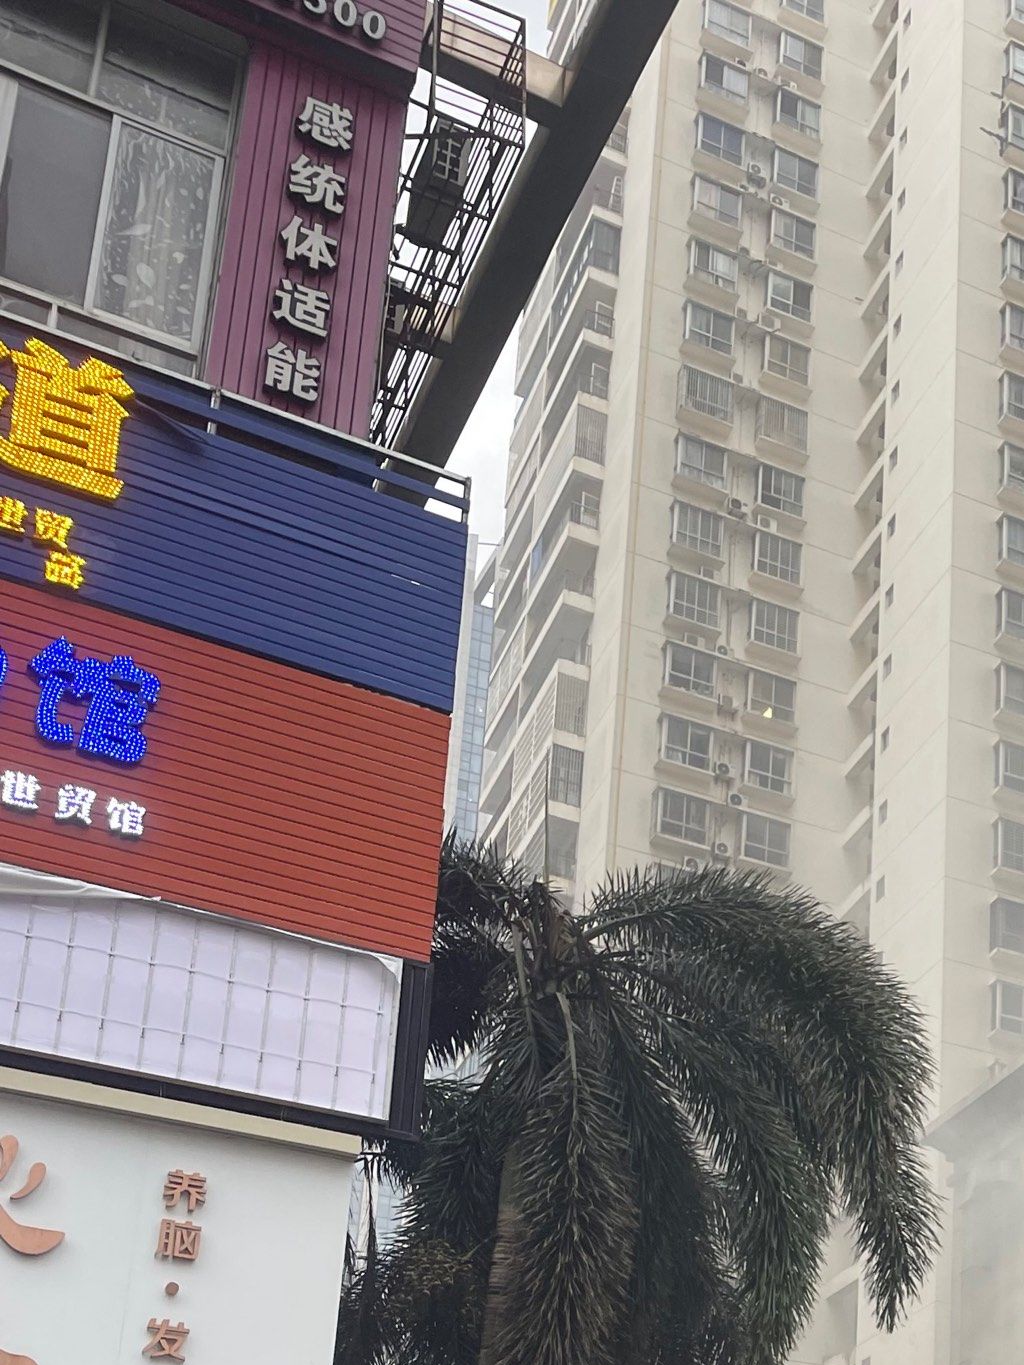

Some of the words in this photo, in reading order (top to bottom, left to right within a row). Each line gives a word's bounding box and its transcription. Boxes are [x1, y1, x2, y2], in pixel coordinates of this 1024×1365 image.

[263, 96, 354, 402] 感统体适能
[0, 336, 135, 499] 道
[0, 635, 160, 762] 馆
[0, 769, 146, 836] 世贸馆
